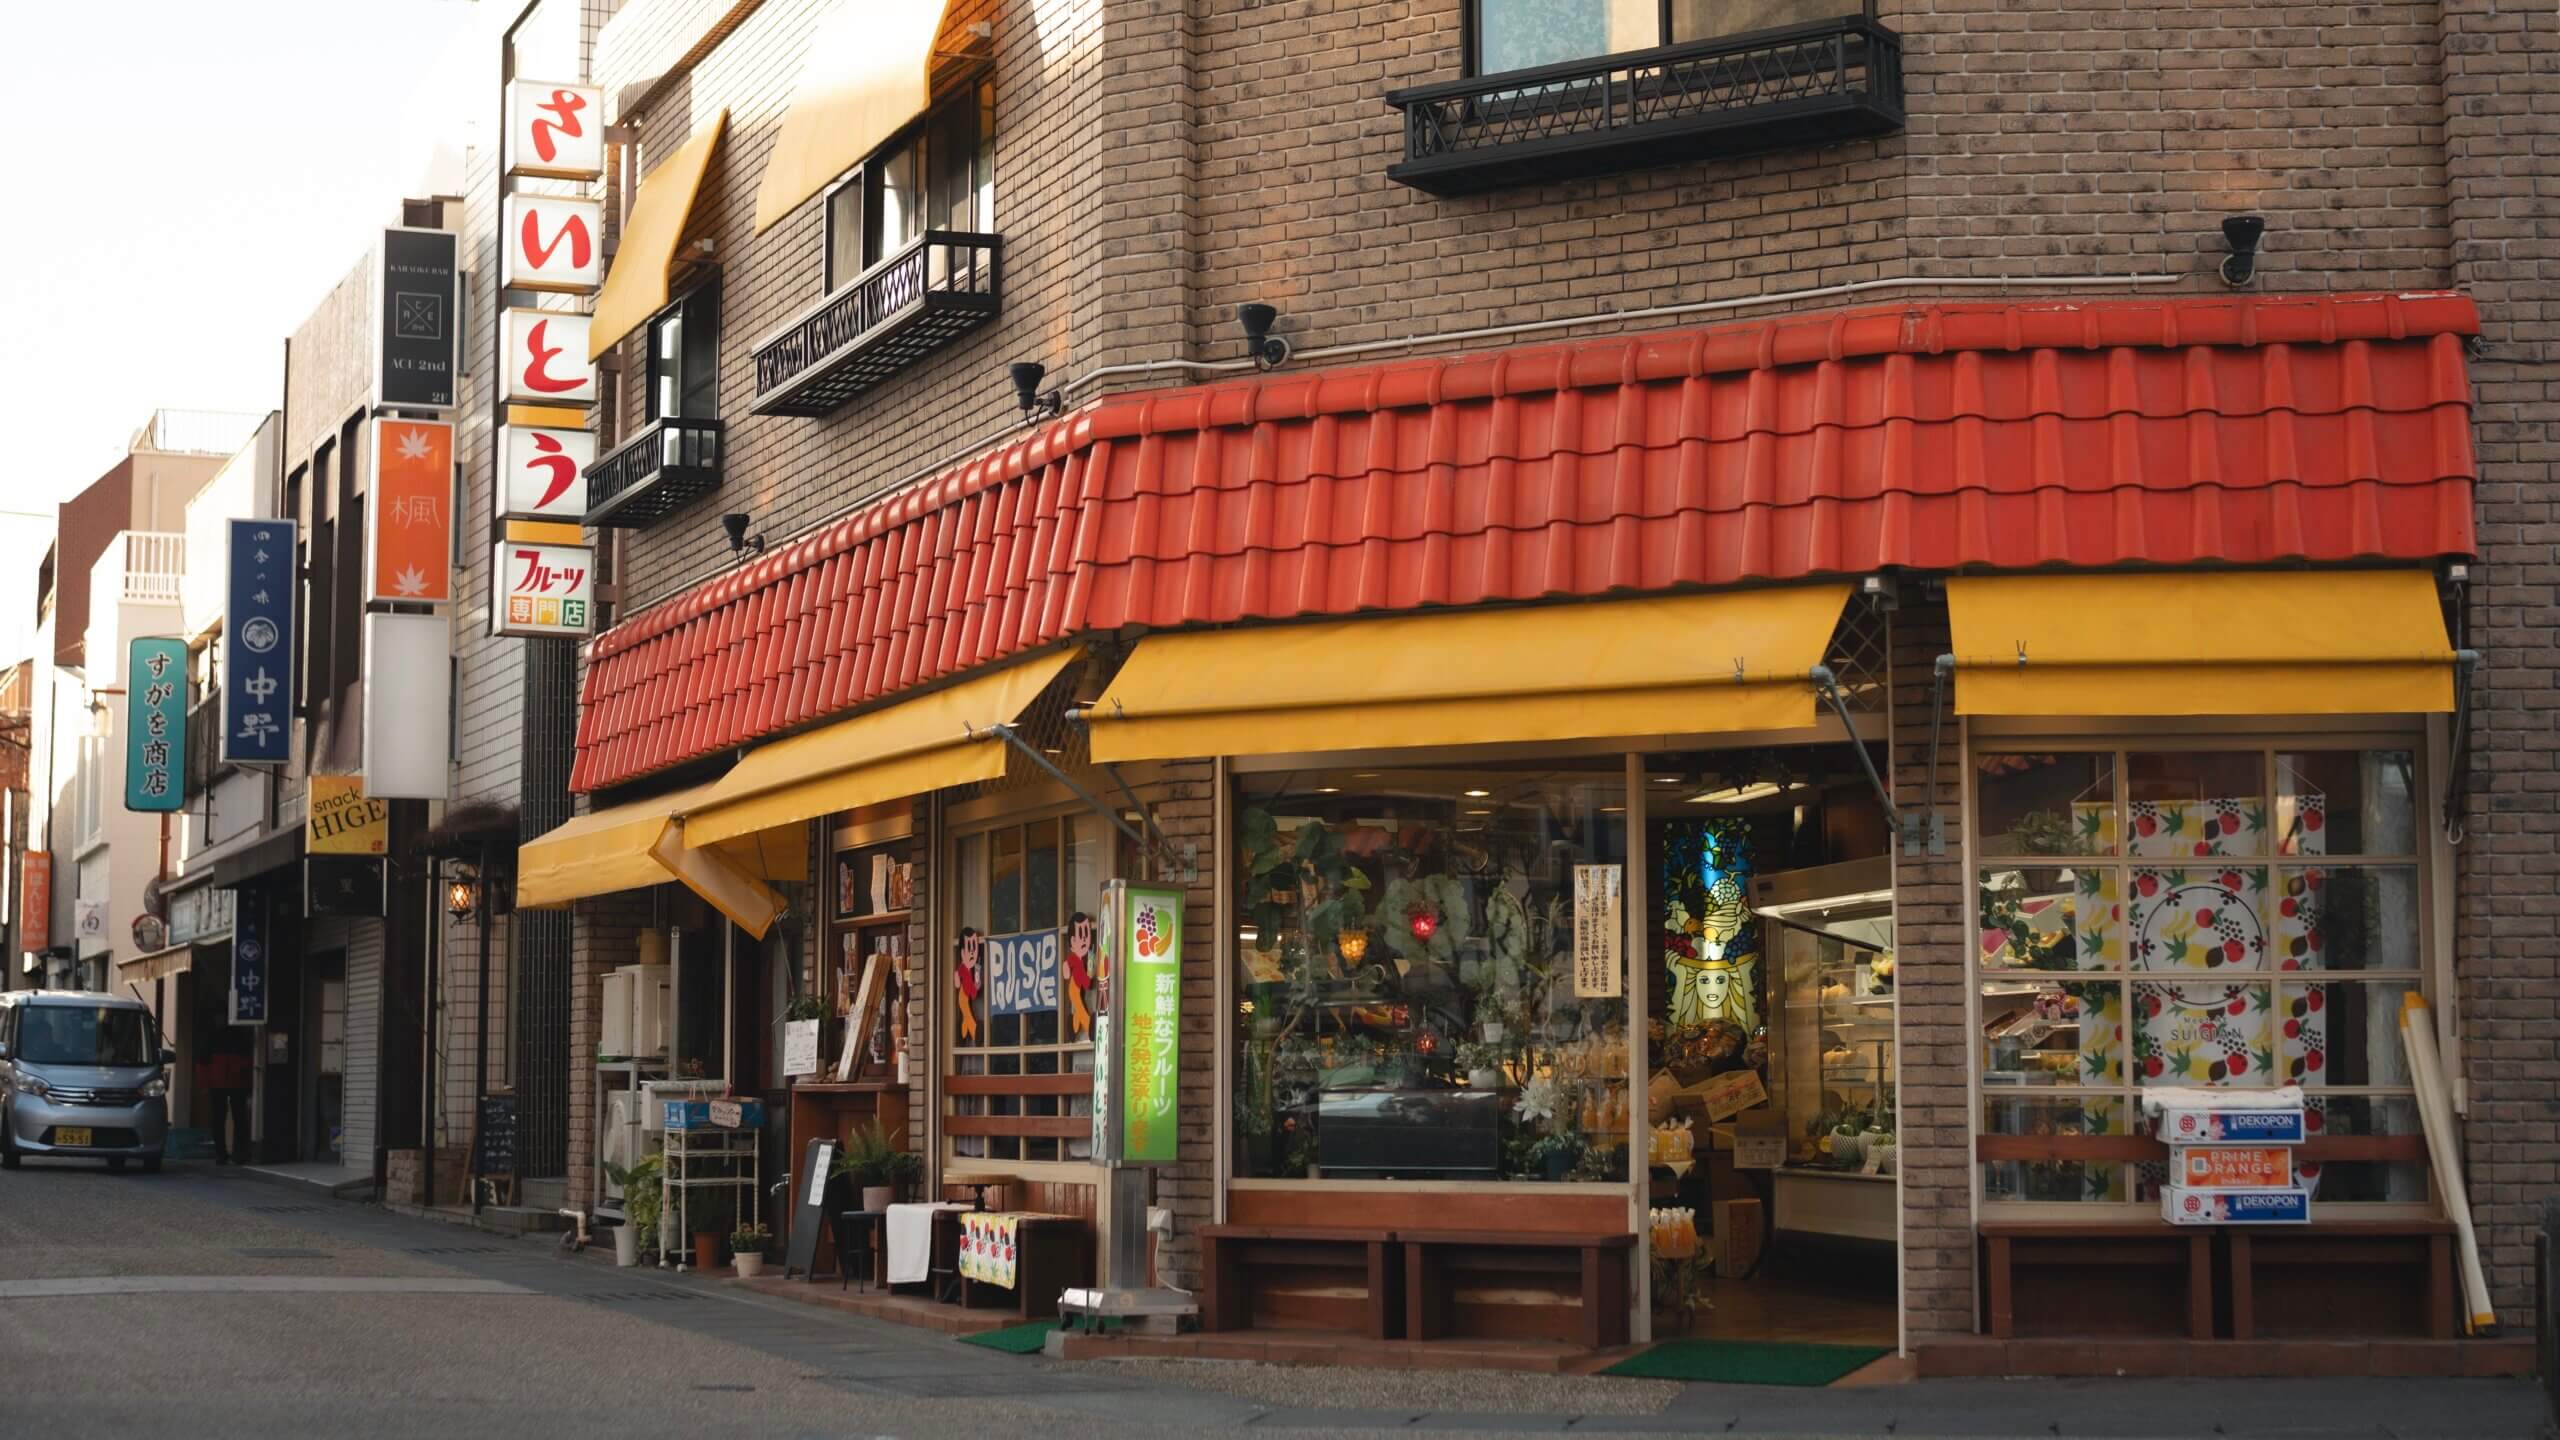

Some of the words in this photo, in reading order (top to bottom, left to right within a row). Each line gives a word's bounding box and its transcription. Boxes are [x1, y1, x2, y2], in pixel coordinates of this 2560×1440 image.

[522, 89, 591, 510] さいとう
[391, 358, 415, 370] ACE
[418, 359, 446, 372] 2nd
[513, 549, 585, 594] フルーツ
[511, 597, 585, 626] 専門店
[140, 651, 172, 796] すがを商店
[236, 665, 280, 749] 中野
[310, 799, 387, 841] HIGE
[313, 786, 361, 813] snack
[1152, 972, 1176, 1117] 新鮮なフルーツ
[1130, 1012, 1153, 1153] 地方発送承ります
[2238, 1115, 2294, 1126] DEKOPON
[2210, 1151, 2263, 1163] PRIME
[2243, 1195, 2299, 1207] DEKOPON
